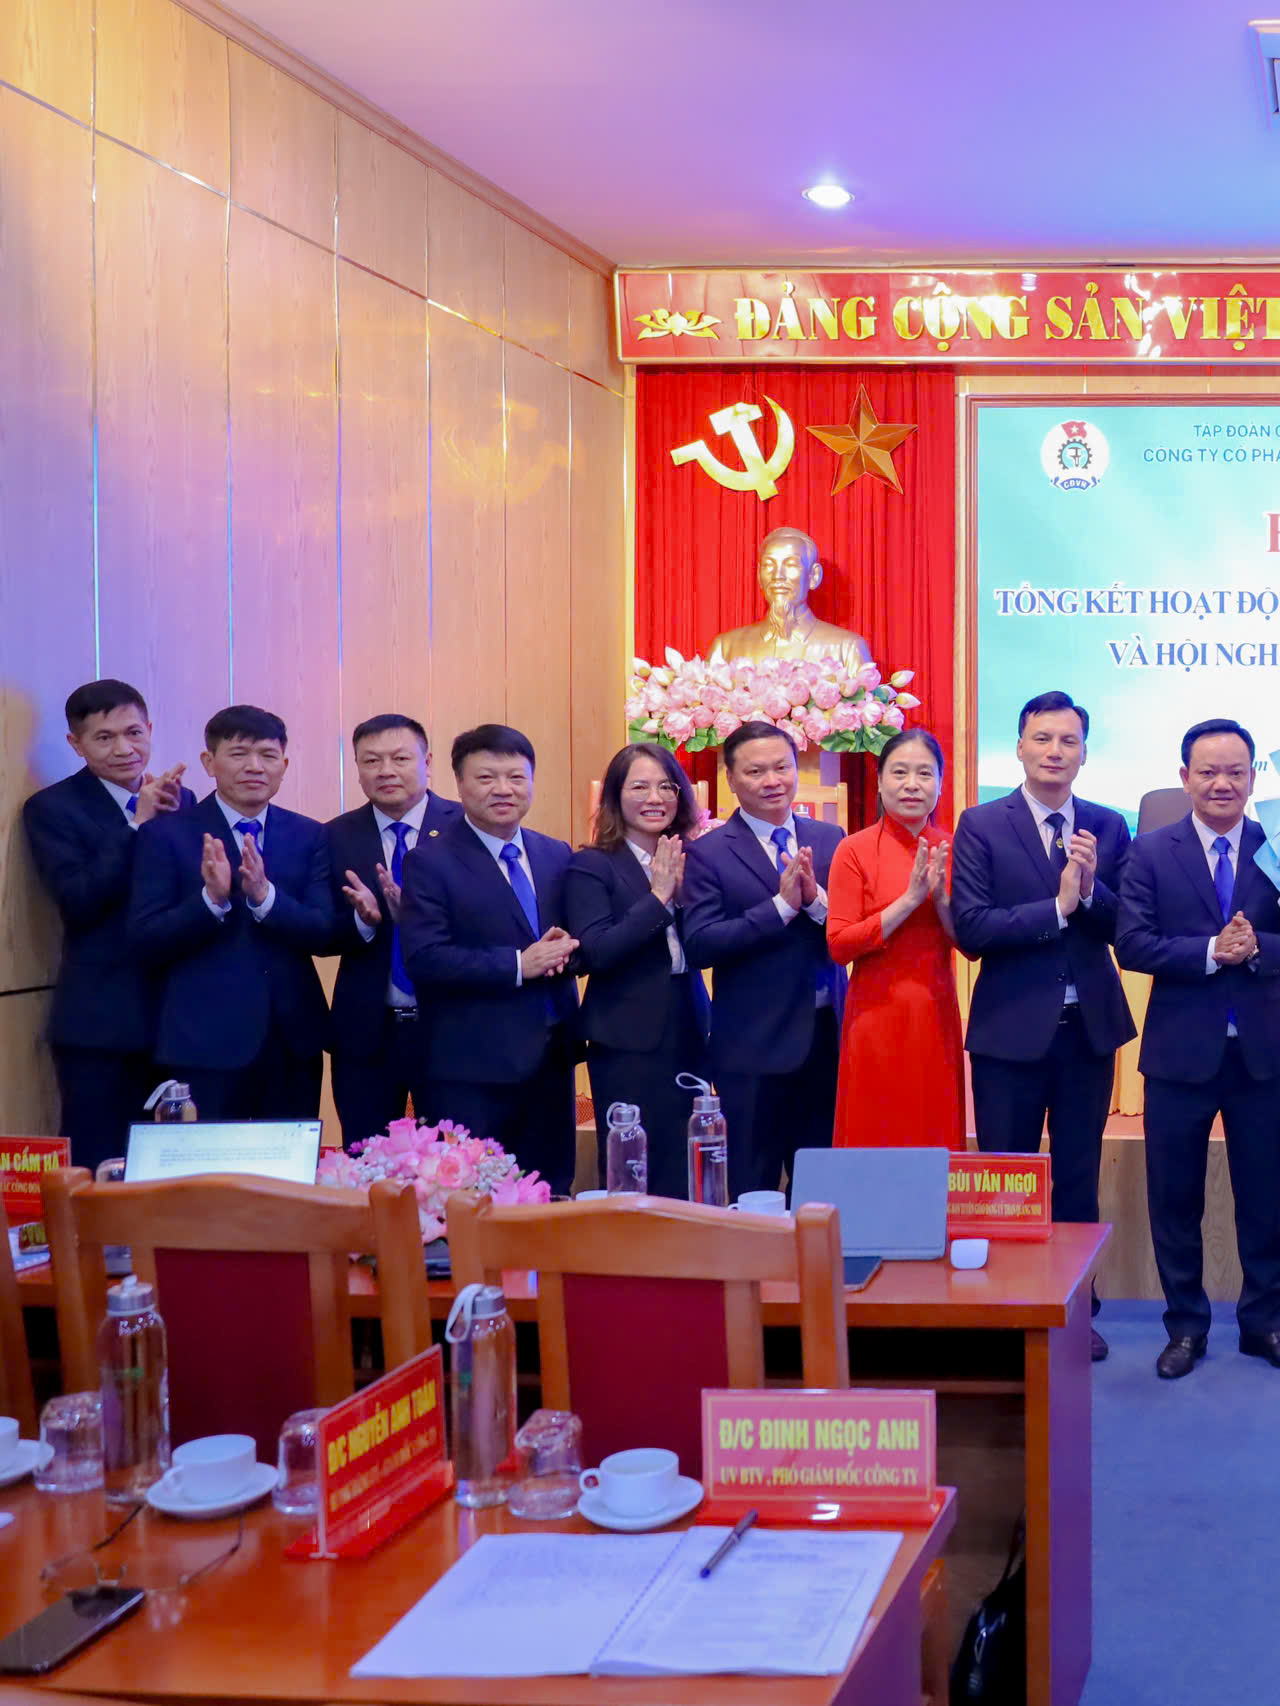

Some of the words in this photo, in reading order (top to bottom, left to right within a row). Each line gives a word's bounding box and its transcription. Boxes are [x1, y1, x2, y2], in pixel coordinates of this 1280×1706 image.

[733, 280, 878, 341] ĐẢNG
[892, 281, 1030, 352] CỘNG
[1044, 281, 1143, 341] SẢN
[1197, 448, 1218, 462] TY
[1150, 590, 1232, 620] HOẠT
[1108, 636, 1150, 666] VÀ
[1156, 639, 1208, 672] HỘI
[719, 1418, 754, 1450] Đ/C
[759, 1418, 809, 1450] ĐINH
[814, 1418, 871, 1457] NGỌC
[876, 1418, 920, 1450] ANH
